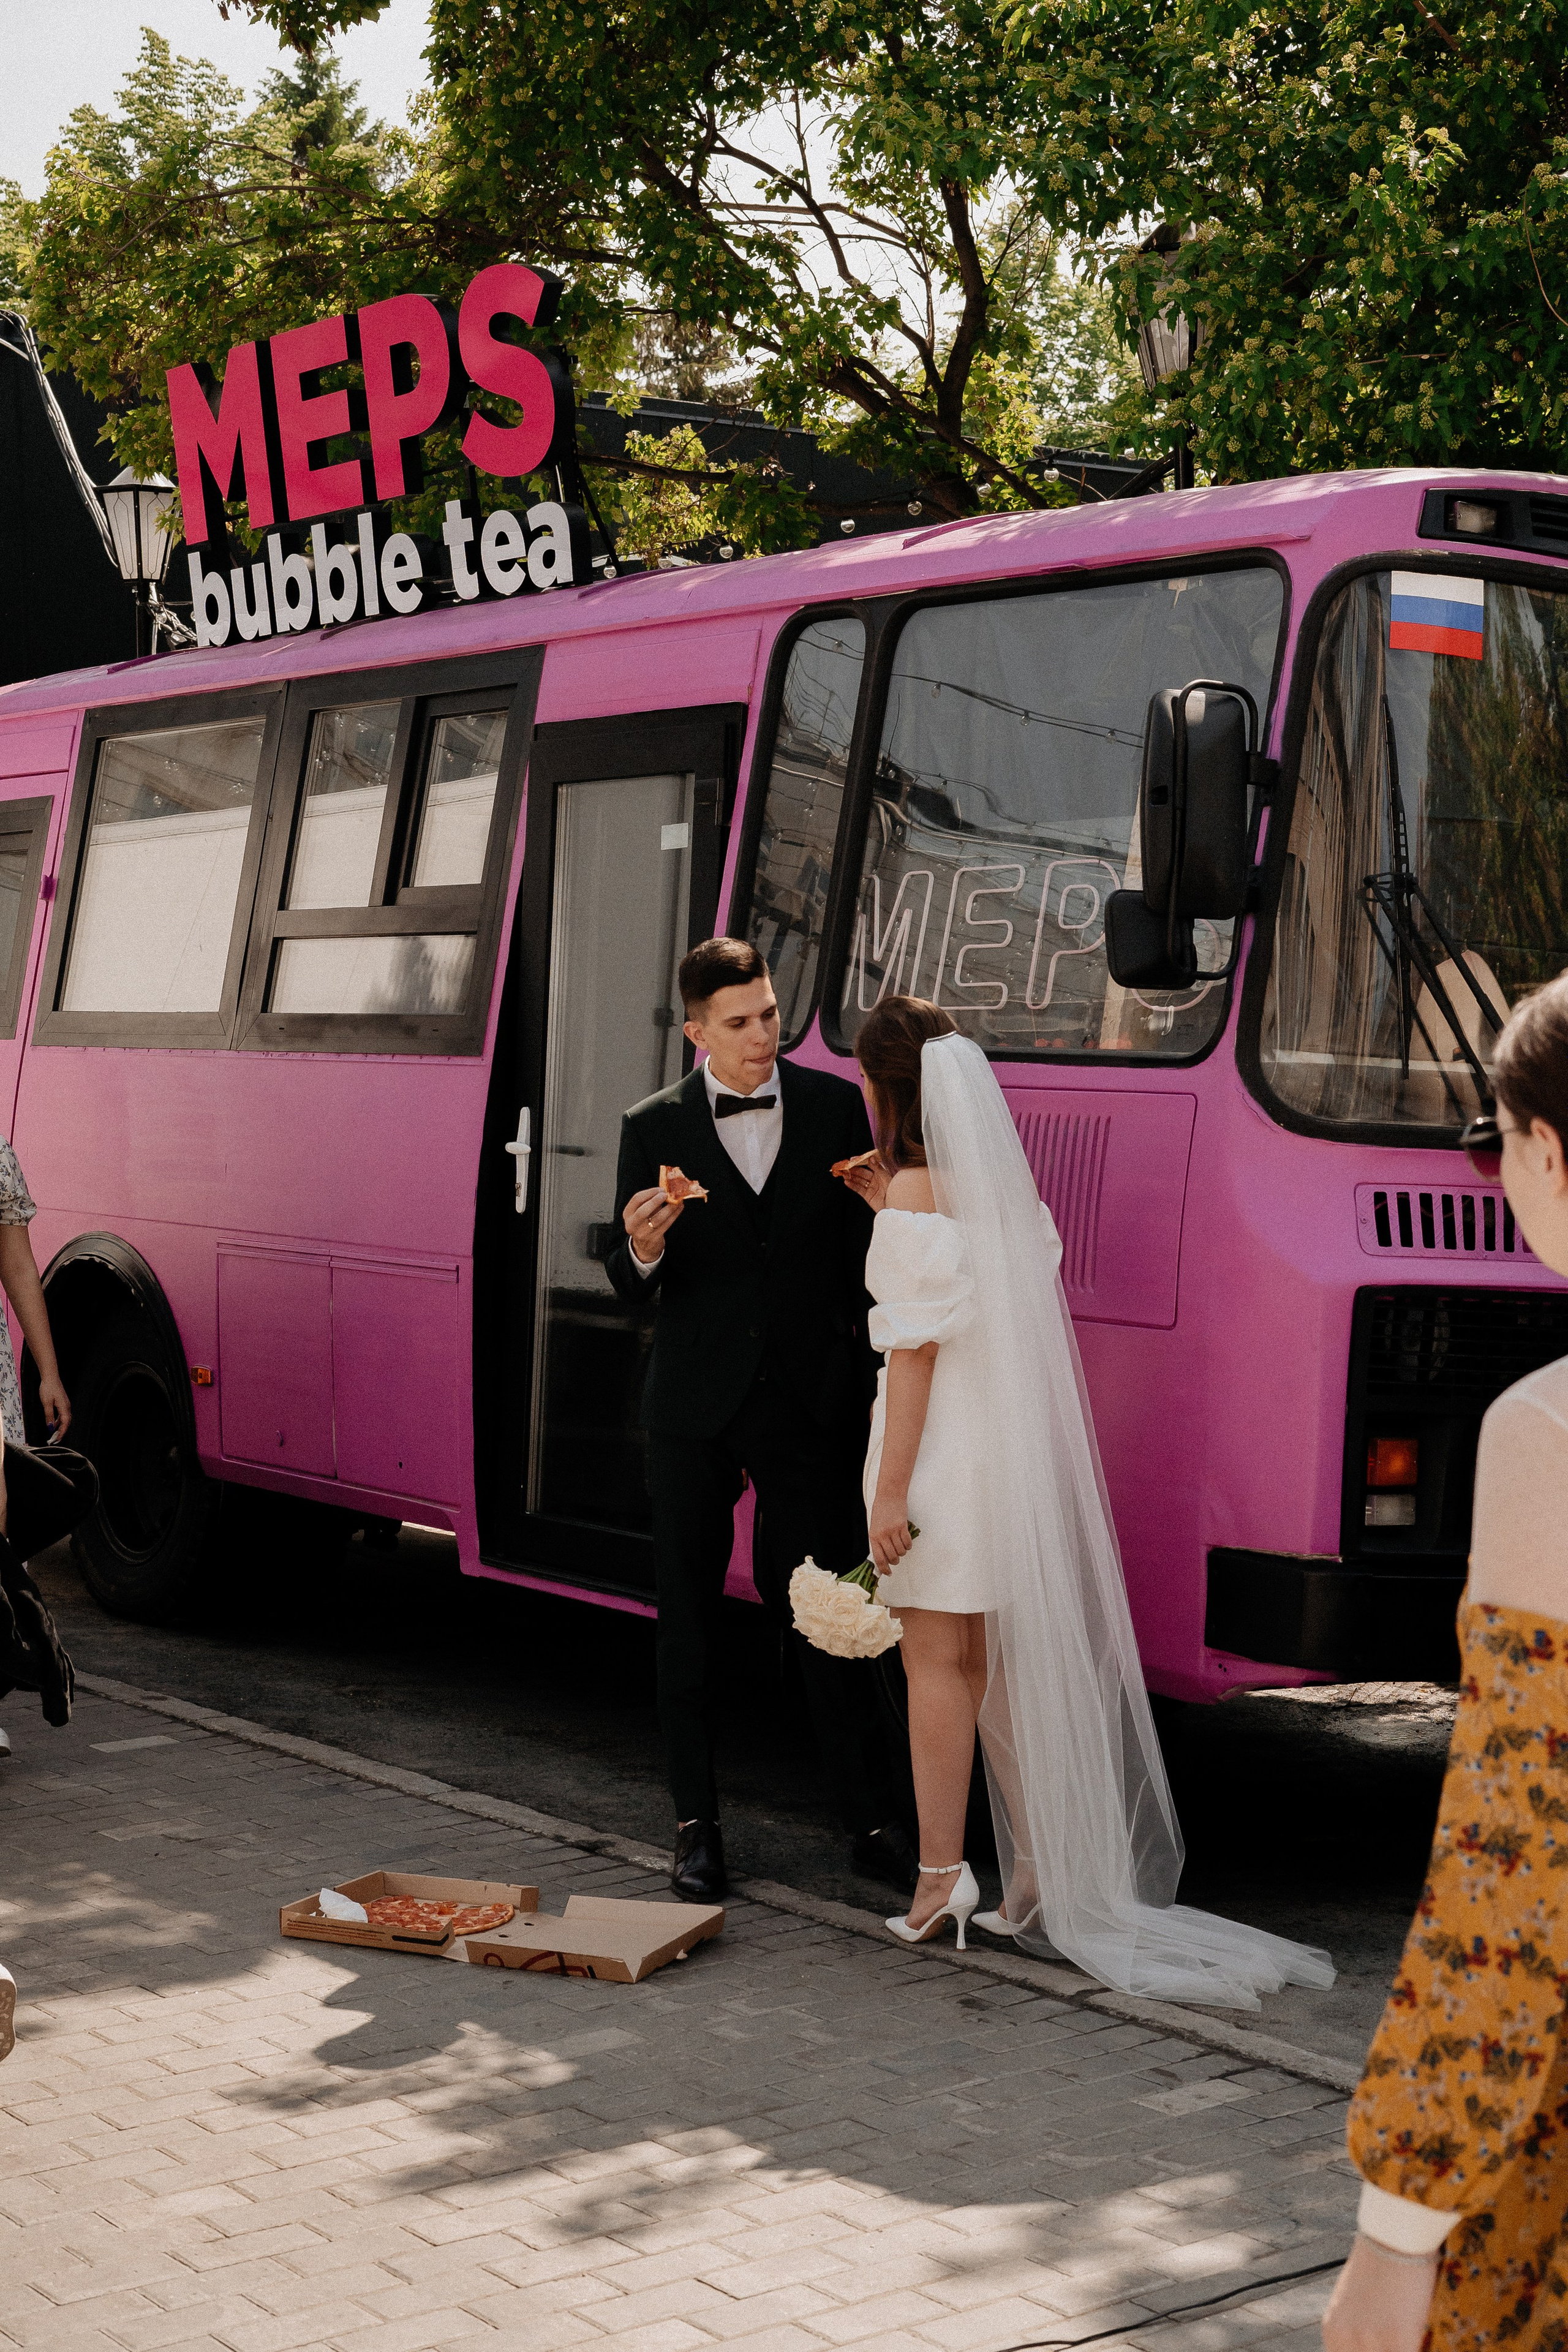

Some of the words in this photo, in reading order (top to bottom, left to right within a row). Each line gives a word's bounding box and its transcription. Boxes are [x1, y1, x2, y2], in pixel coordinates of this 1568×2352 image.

[166, 263, 555, 545] MEPS
[187, 512, 423, 646] bubble
[442, 499, 573, 600] tea
